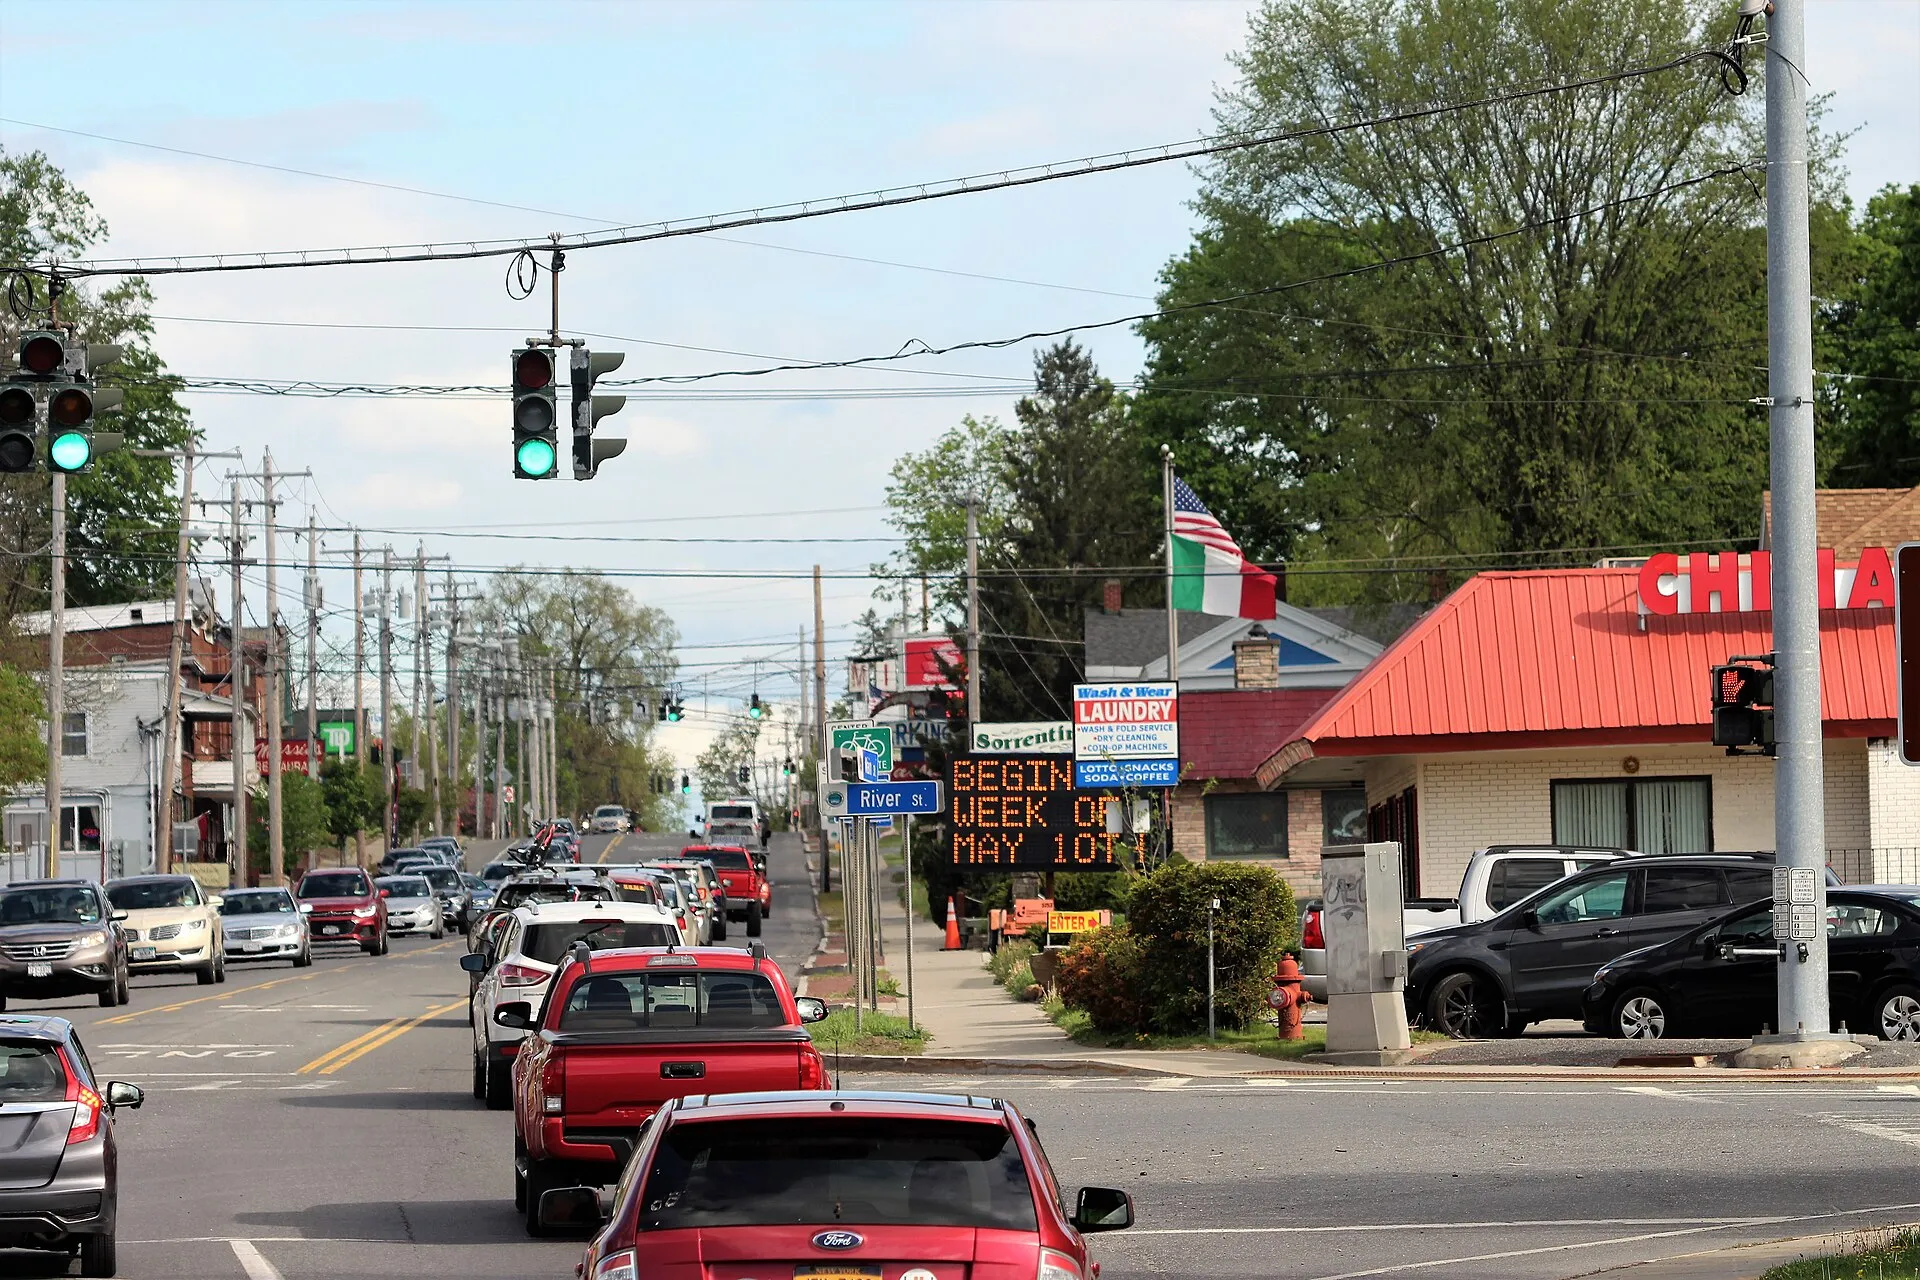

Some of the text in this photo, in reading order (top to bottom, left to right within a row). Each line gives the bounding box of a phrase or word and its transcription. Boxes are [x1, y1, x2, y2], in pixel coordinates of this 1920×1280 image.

[1078, 687, 1172, 698] Wash & Wear
[1080, 701, 1172, 722] LAUNDRY
[1125, 743, 1168, 751] MACHINES
[1080, 763, 1174, 773] LOTTO SNACKS
[953, 760, 1072, 791] BEGIN
[1084, 773, 1170, 782] SODA COFFEE
[860, 789, 901, 808] River
[953, 796, 1120, 828] WEEK OF
[953, 833, 1023, 864] MAY
[1050, 916, 1085, 930] ENTER
[823, 1233, 852, 1247] Ford
[816, 1267, 861, 1275] NEW YORK
